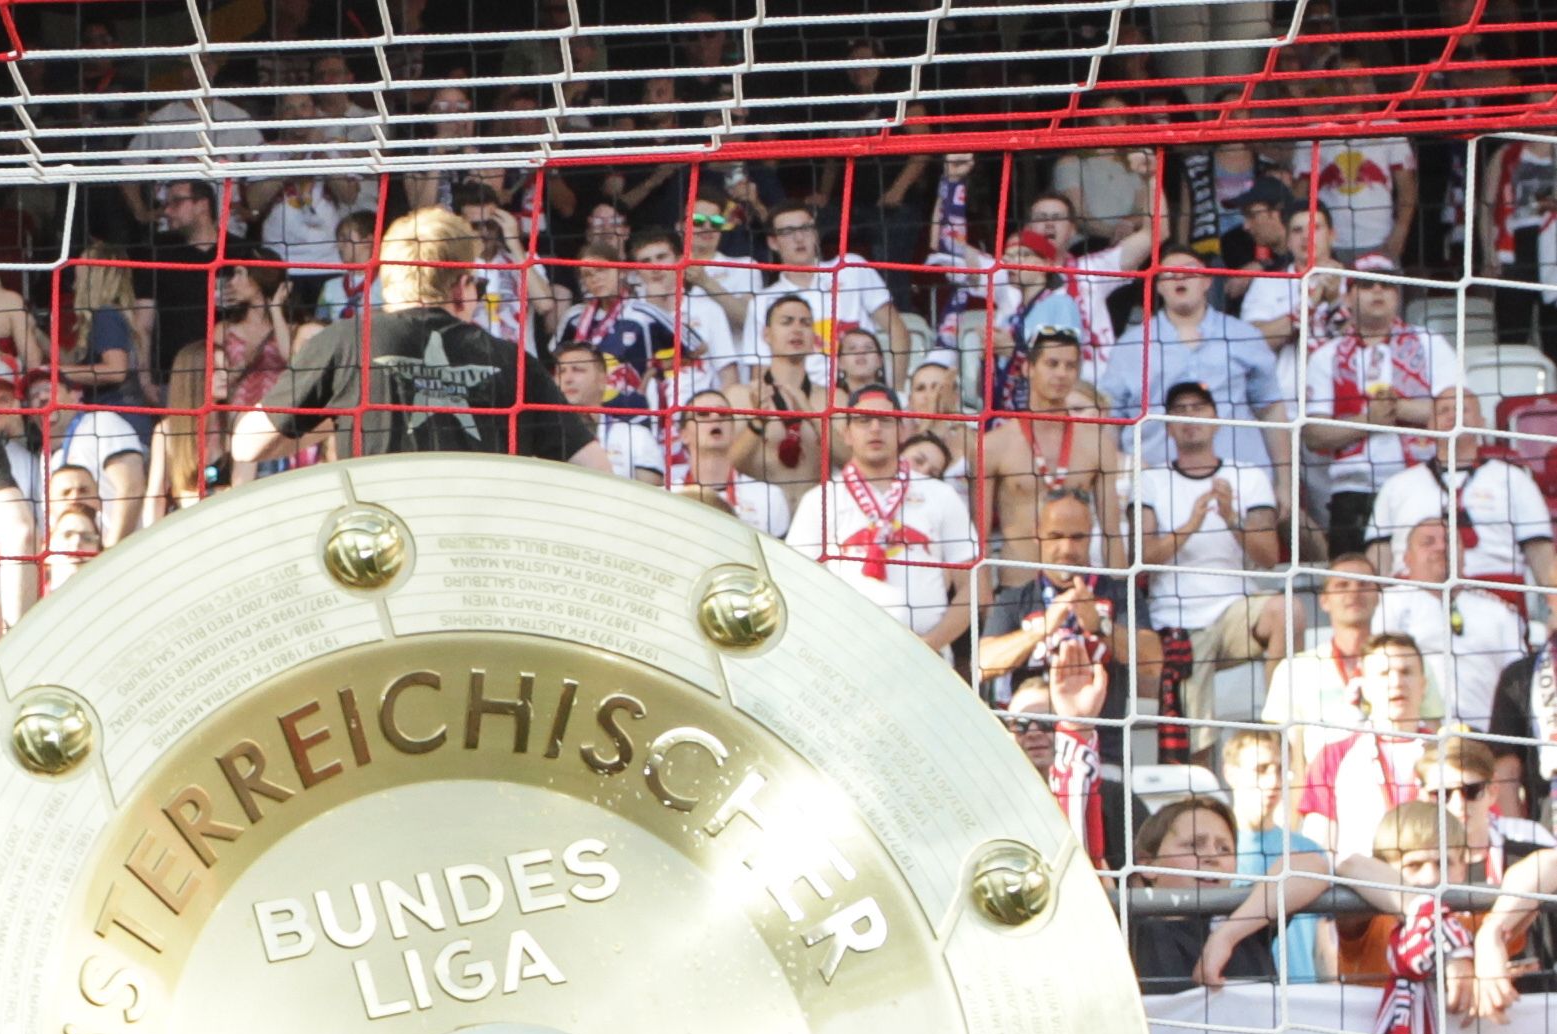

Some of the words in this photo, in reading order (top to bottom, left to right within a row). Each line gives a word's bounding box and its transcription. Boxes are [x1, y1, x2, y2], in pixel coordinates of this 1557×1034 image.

[436, 536, 510, 550] SALZBURG
[513, 538, 547, 554] BULL
[550, 543, 580, 560] RED
[581, 548, 601, 564] FC
[449, 556, 496, 569] MAGNA
[500, 557, 560, 576] AUSTRIA
[563, 564, 582, 579] FK
[442, 575, 515, 589] SALZBURG
[518, 577, 567, 596] CASINO
[569, 584, 588, 600] SV
[583, 568, 657, 600] 2005/2006
[186, 599, 215, 623] RED
[212, 590, 233, 609] FC
[232, 581, 302, 620] 2006/2007
[270, 590, 339, 626] 1997/1998
[461, 594, 497, 607] WIEN
[501, 594, 543, 611] RAPID
[545, 599, 564, 614] SK
[589, 588, 662, 621] 1996/1997
[205, 610, 235, 634] RED
[251, 616, 272, 634] SK
[438, 613, 503, 626] MEMPHIS
[507, 614, 566, 634] AUSTRIA
[566, 602, 639, 633] 1987/1988
[567, 622, 587, 639] FK
[175, 625, 208, 652] BULL
[256, 615, 326, 653] 1988/1989
[589, 627, 661, 662] 1978/1979
[173, 625, 254, 680] PUNTIGAMER
[237, 644, 258, 663] FC
[270, 632, 339, 669] 1979/1980
[114, 645, 177, 698] SALZBURG
[172, 654, 241, 705] SWAROVSKI
[252, 660, 272, 678] FK
[795, 645, 862, 698] SALZBURG
[134, 672, 177, 710] STURM
[201, 670, 254, 709] AUSTRIA
[795, 688, 832, 721] WIEN
[808, 676, 844, 708] WIEN
[106, 703, 139, 734] GRAZ
[140, 697, 176, 730] TIROL
[782, 702, 819, 734] WIEN
[840, 701, 880, 739] RAPID
[857, 692, 891, 725] BULL
[149, 702, 204, 750] MEMPHIS
[827, 714, 867, 752] RAPID
[885, 719, 915, 749] RED
[815, 727, 854, 764] RAPID
[908, 743, 929, 765] FC
[49, 891, 65, 911] FK
[254, 838, 621, 963] BUNDES
[32, 910, 59, 971] AUSTRIA
[354, 930, 566, 1019] LIGA
[3, 986, 19, 1026] TIROL
